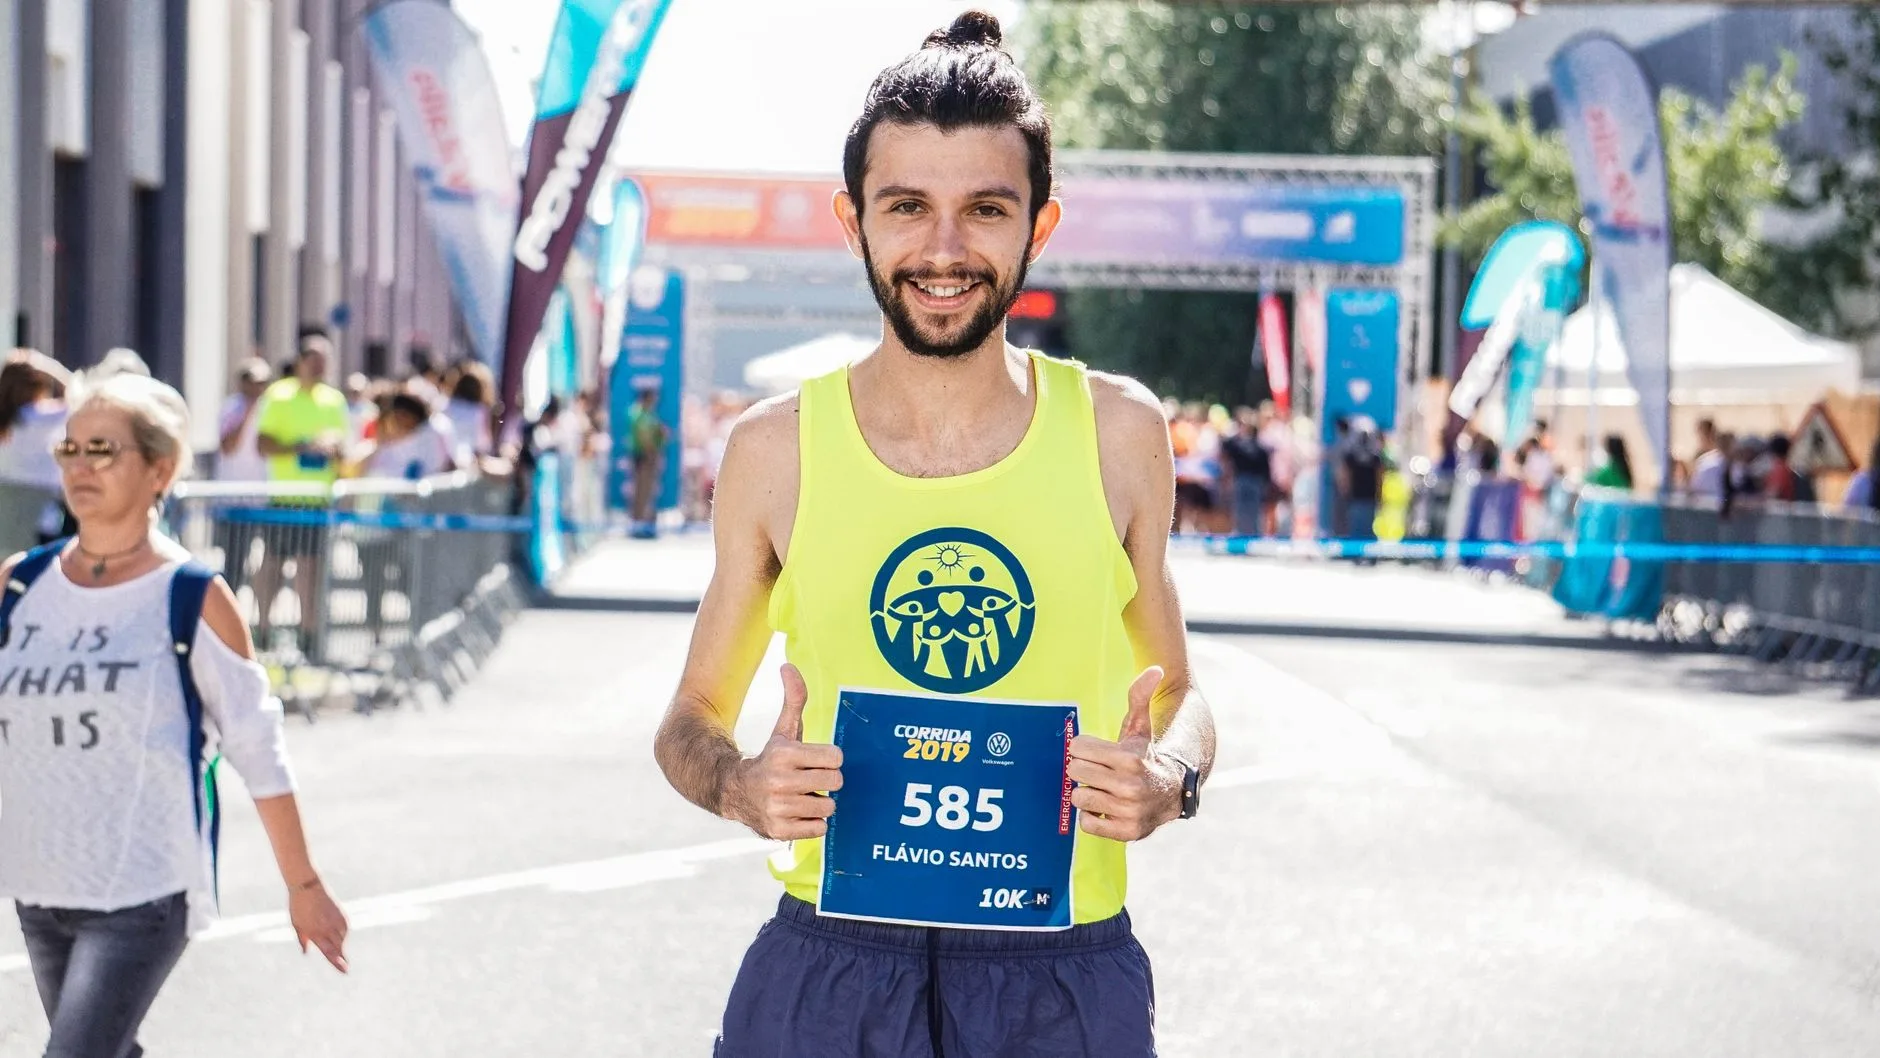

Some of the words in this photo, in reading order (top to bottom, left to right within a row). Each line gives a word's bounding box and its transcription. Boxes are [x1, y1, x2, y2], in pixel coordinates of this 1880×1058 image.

[69, 625, 110, 653] IS
[51, 710, 100, 750] IS
[894, 724, 972, 743] CORRIDA
[903, 738, 971, 763] 2019
[981, 758, 1015, 766] Volkswagen
[899, 782, 1005, 832] 585
[1061, 776, 1073, 832] EMERGÊNCIA
[872, 842, 945, 866] FLÁVIO
[949, 851, 1028, 870] SANTOS
[979, 888, 1028, 909] 10K
